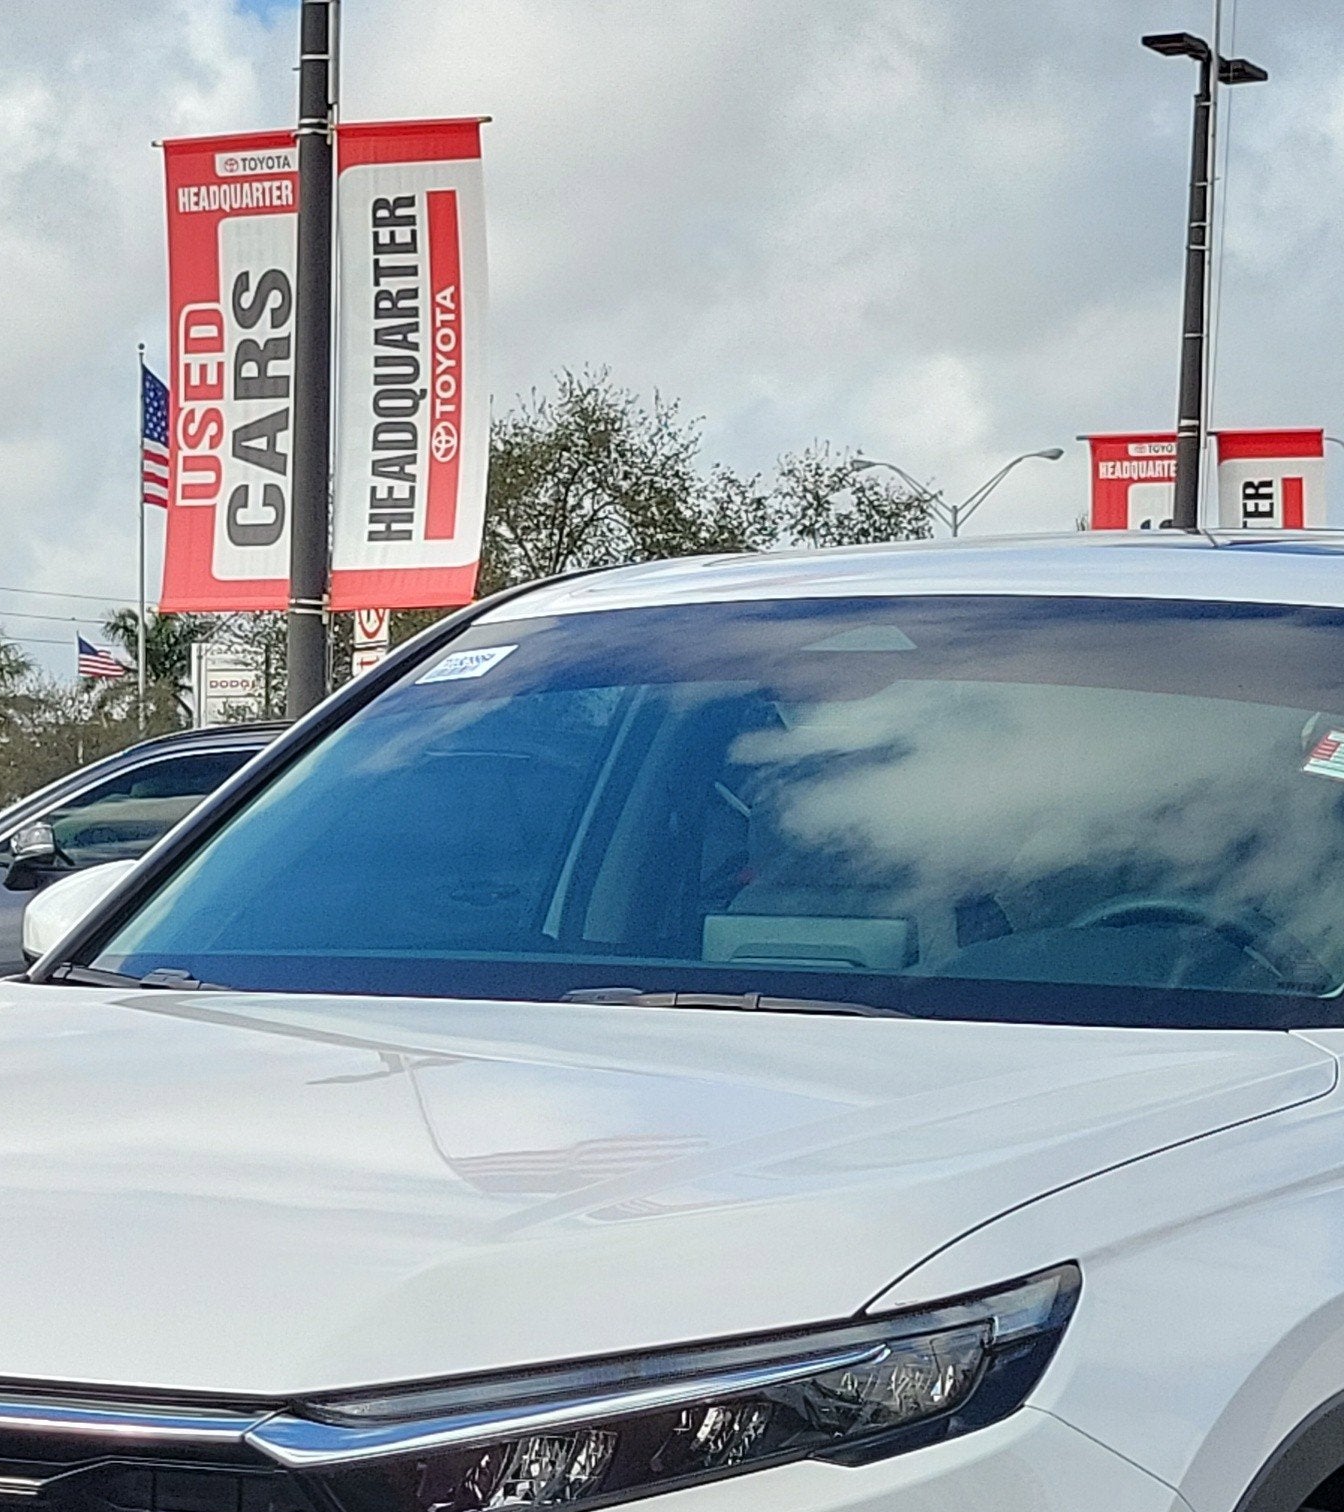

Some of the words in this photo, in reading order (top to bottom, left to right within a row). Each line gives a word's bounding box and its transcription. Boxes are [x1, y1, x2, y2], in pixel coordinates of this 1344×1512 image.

[177, 180, 293, 213] HEADQUARTER
[240, 155, 292, 172] TOYOTA
[367, 194, 427, 543] HEADQUARTER
[435, 285, 457, 418] TOYOTA
[176, 303, 225, 506] USED
[227, 268, 292, 548] CARS
[1098, 459, 1177, 480] HEADQUARTE
[1148, 442, 1175, 454] TOYO
